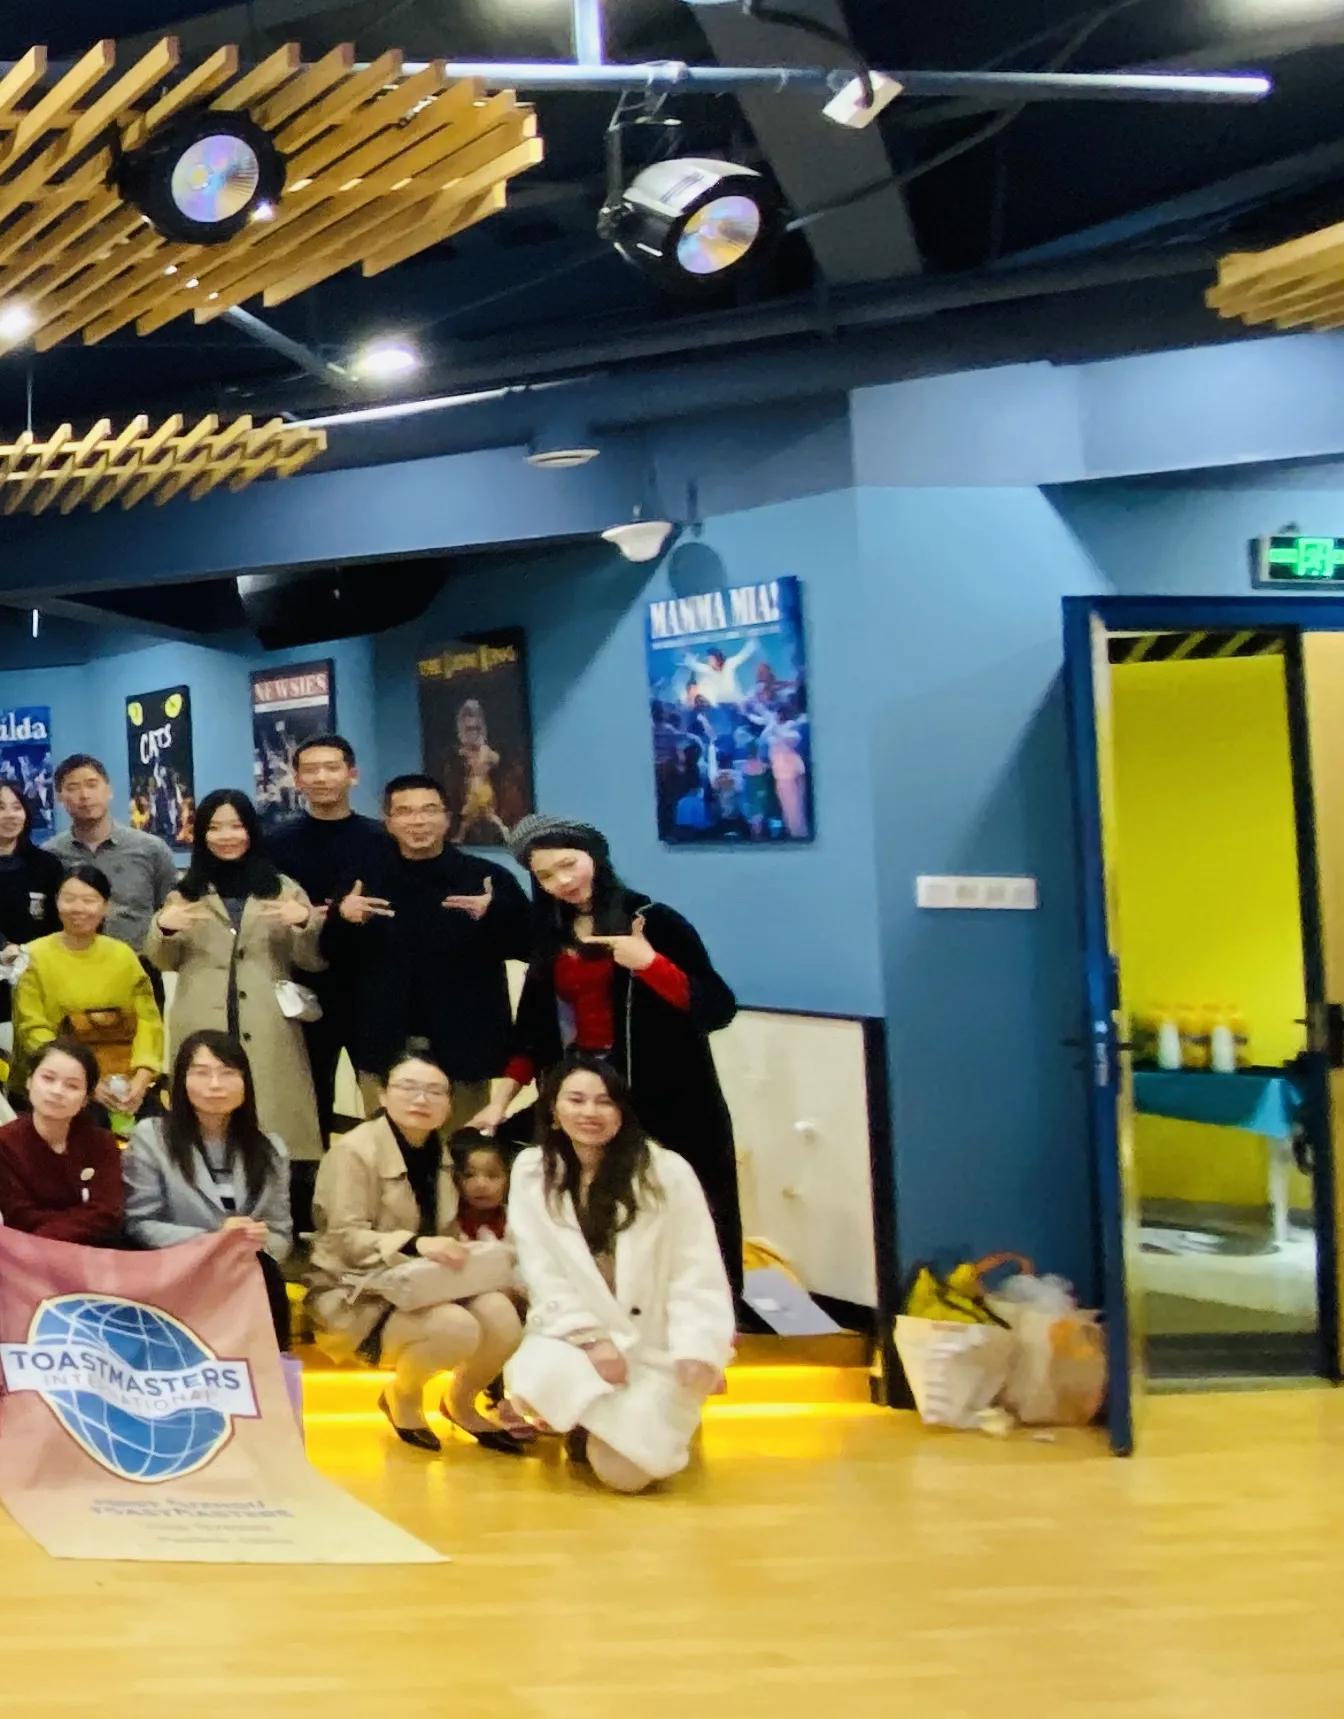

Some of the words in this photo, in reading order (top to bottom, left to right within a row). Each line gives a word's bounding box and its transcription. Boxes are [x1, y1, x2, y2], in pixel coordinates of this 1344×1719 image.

[650, 592, 727, 639] MAMMA
[728, 581, 780, 627] MIA!
[9, 1350, 241, 1396] TOASTMASTERS
